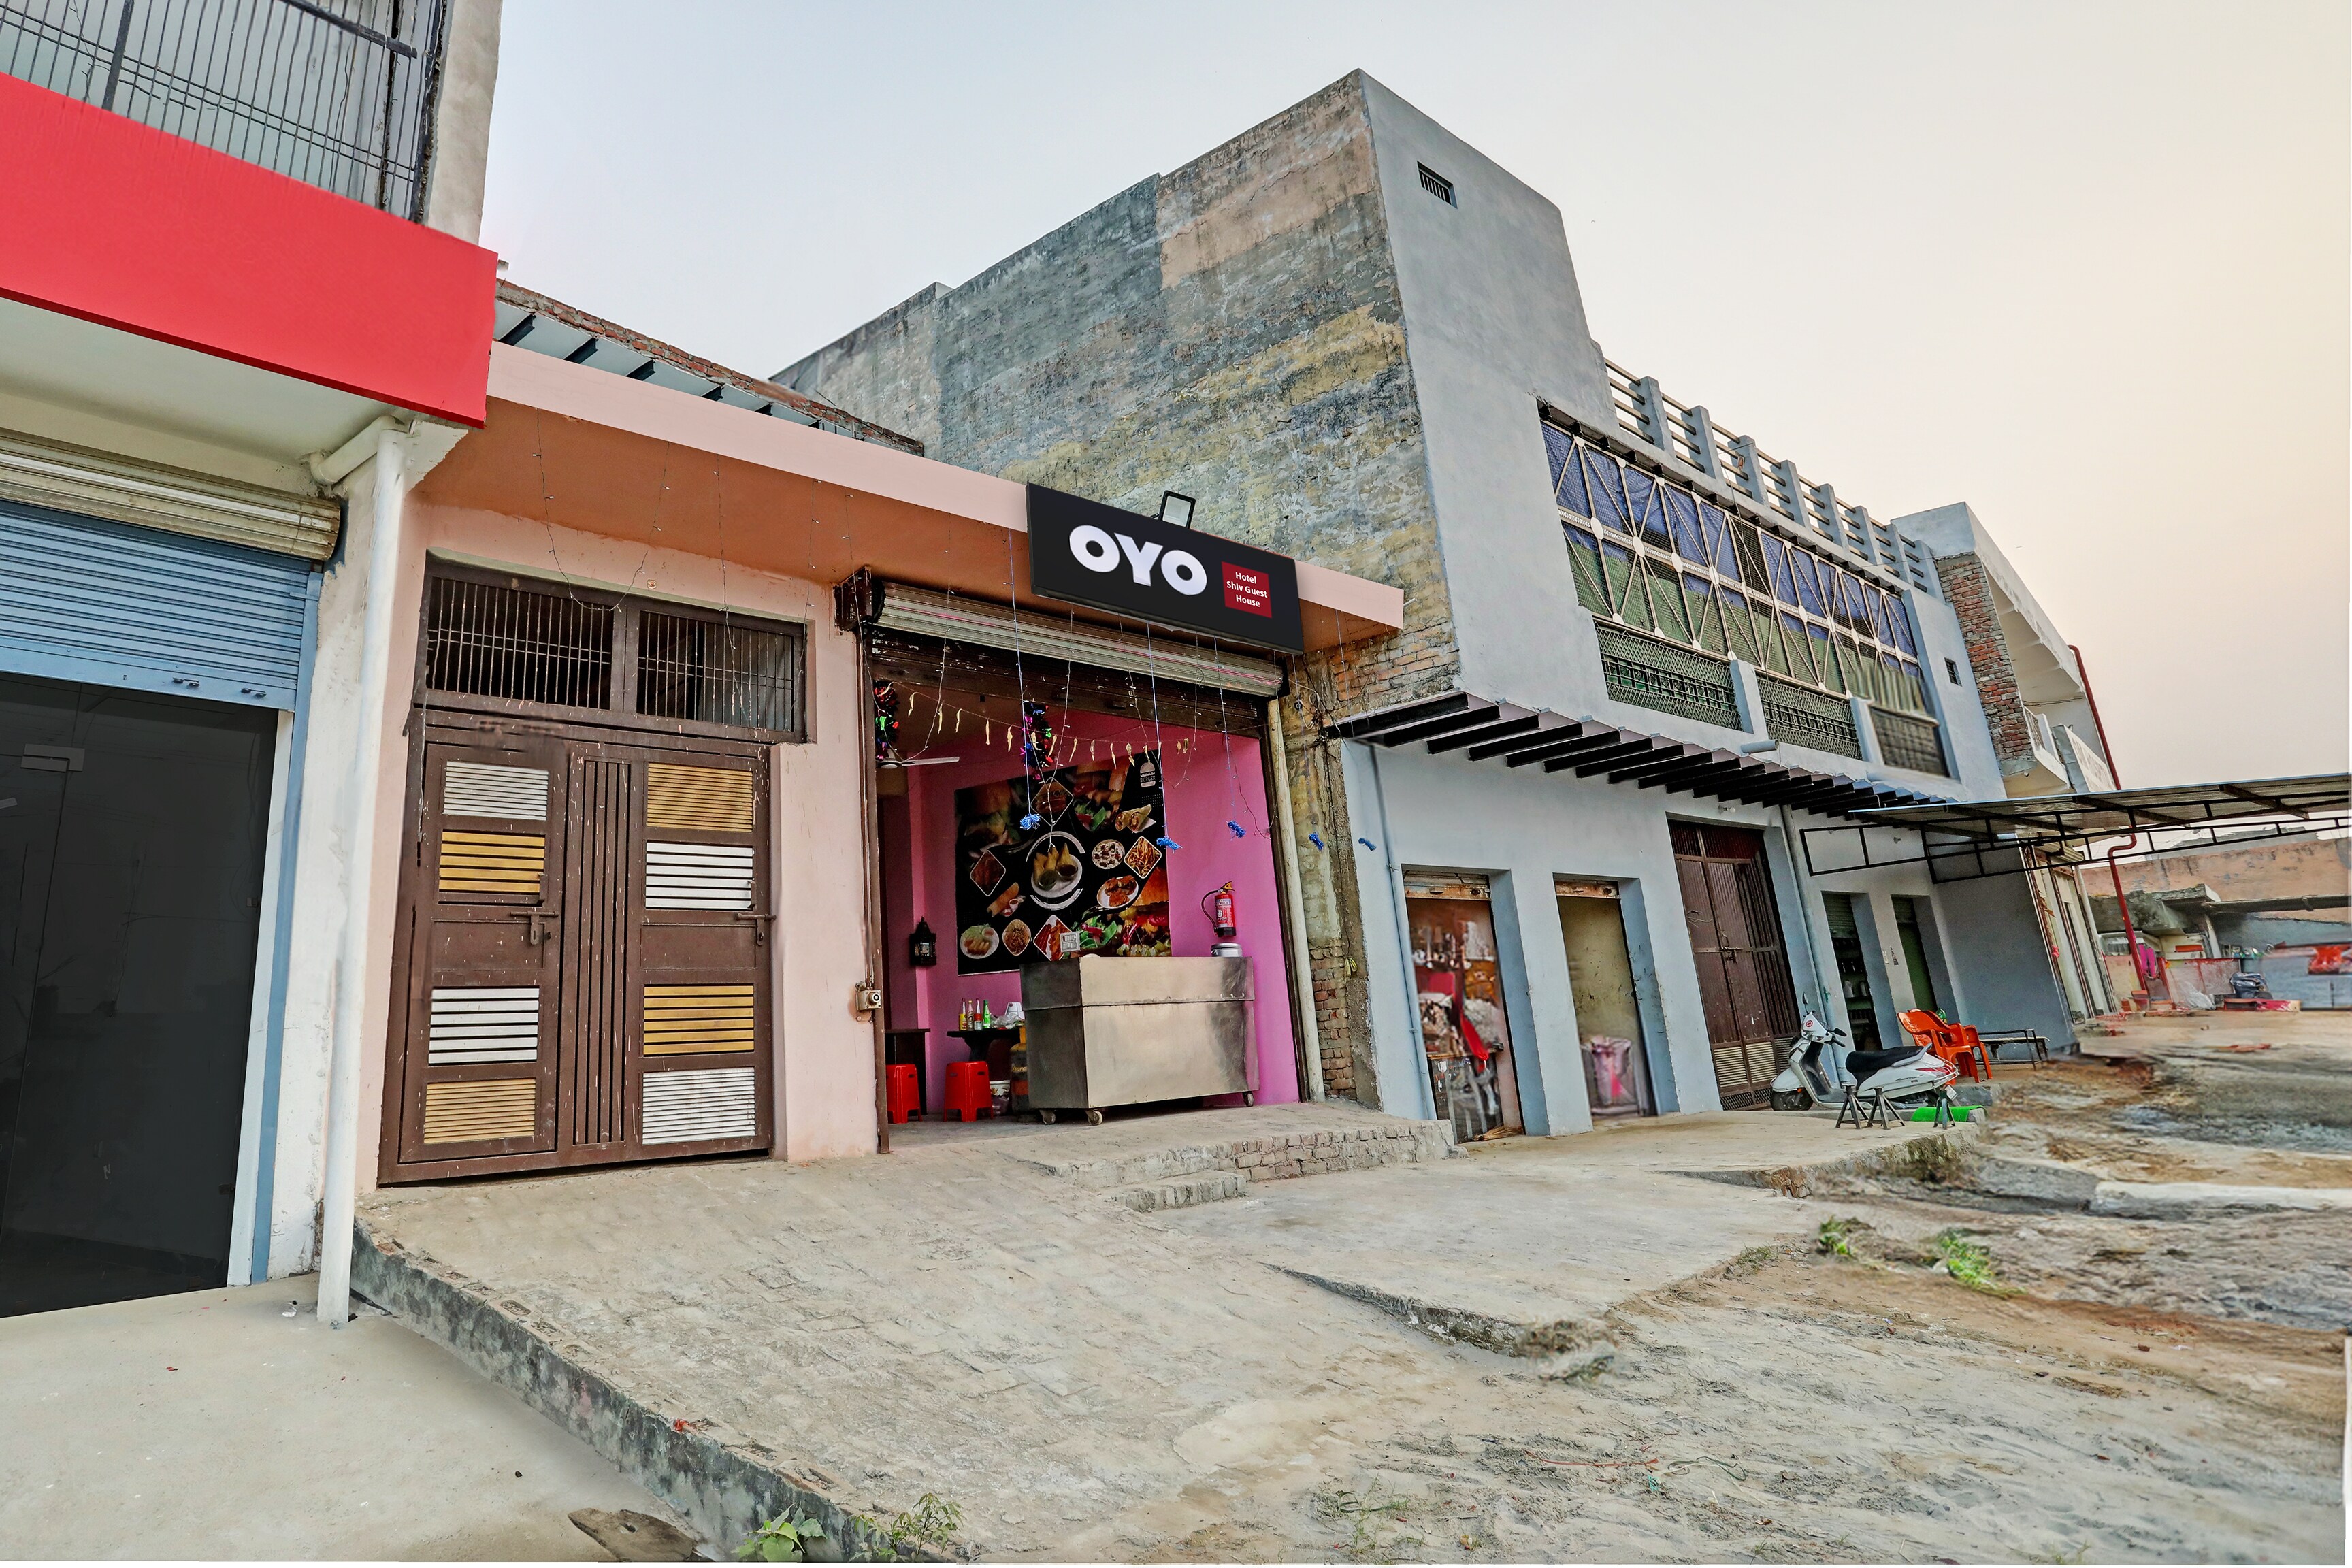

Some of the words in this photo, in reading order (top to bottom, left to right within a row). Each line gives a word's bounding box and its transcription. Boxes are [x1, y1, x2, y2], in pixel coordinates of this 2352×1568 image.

[1069, 525, 1207, 595] OYO
[1235, 572, 1257, 584] Hotel
[1245, 586, 1268, 598] Guest
[1236, 594, 1260, 607] House
